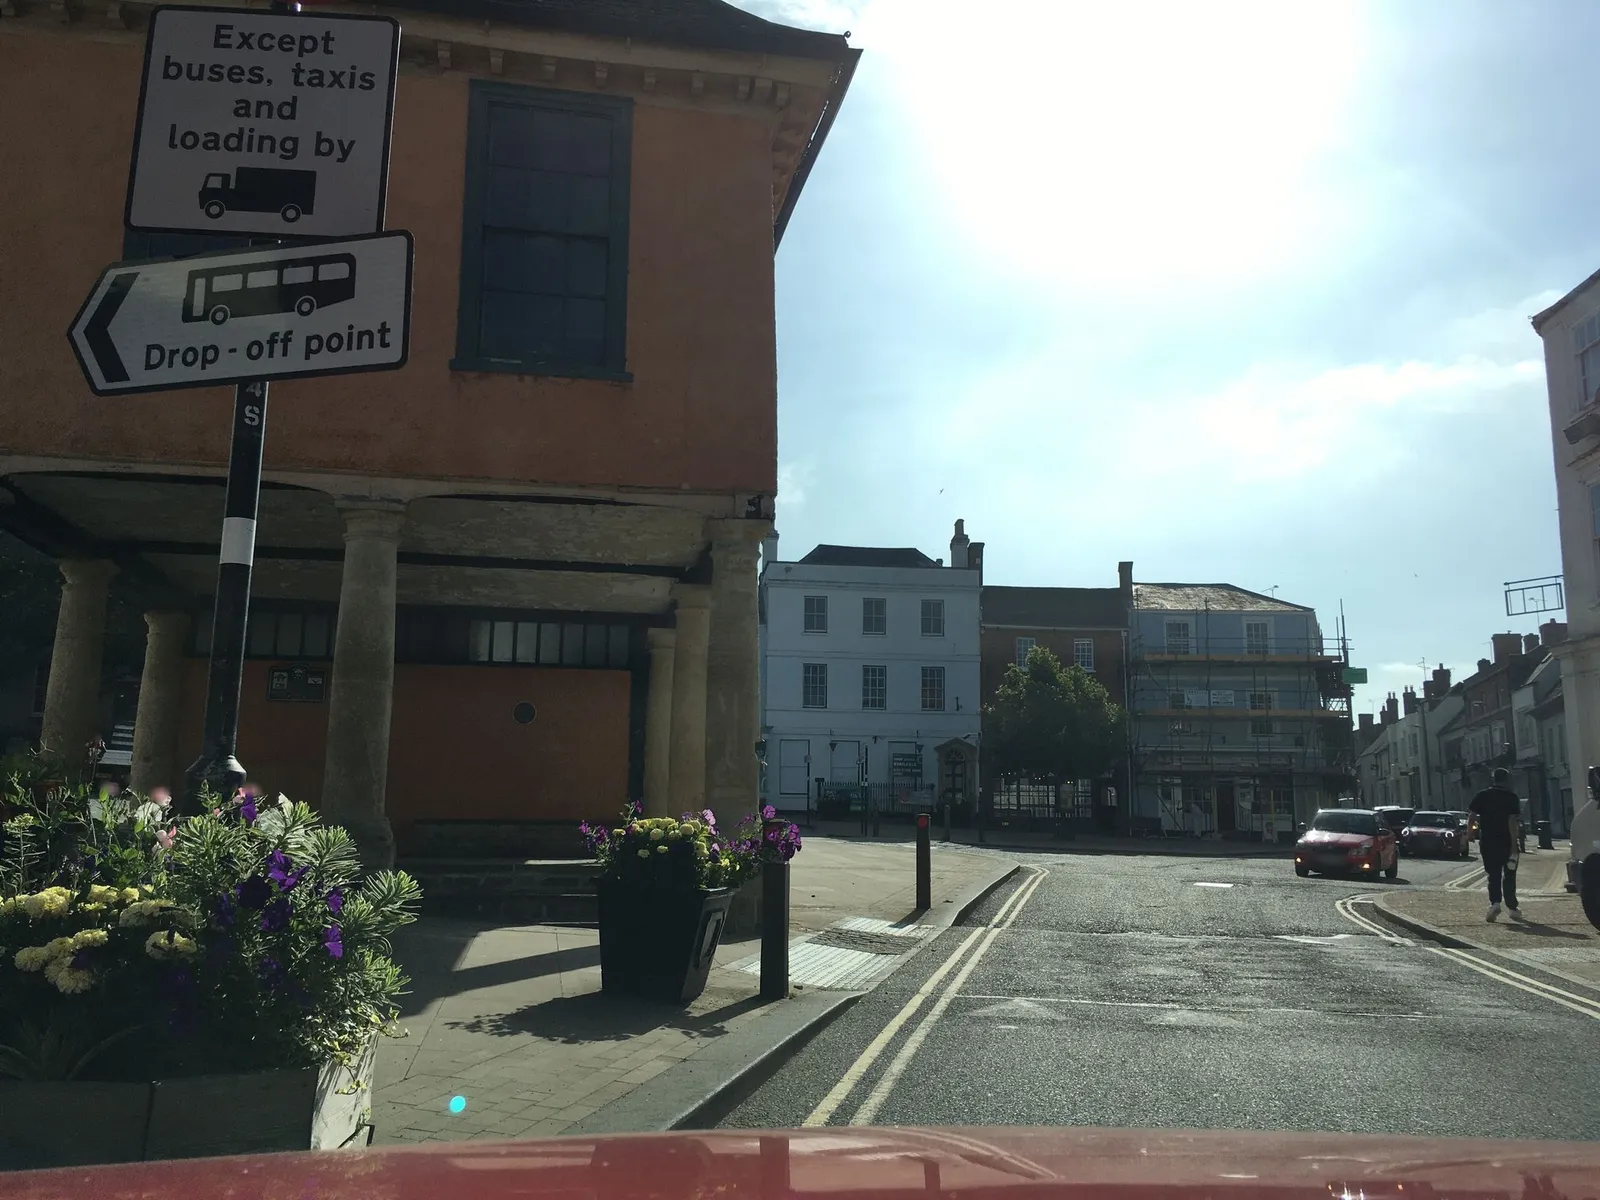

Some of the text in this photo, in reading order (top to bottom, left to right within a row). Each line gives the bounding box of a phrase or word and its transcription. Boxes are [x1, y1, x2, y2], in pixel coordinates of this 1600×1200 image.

[212, 24, 335, 57] Except
[162, 56, 376, 91] buses, taxis
[232, 96, 299, 121] and
[168, 124, 357, 163] loading by
[304, 321, 391, 360] point
[244, 405, 260, 426] S
